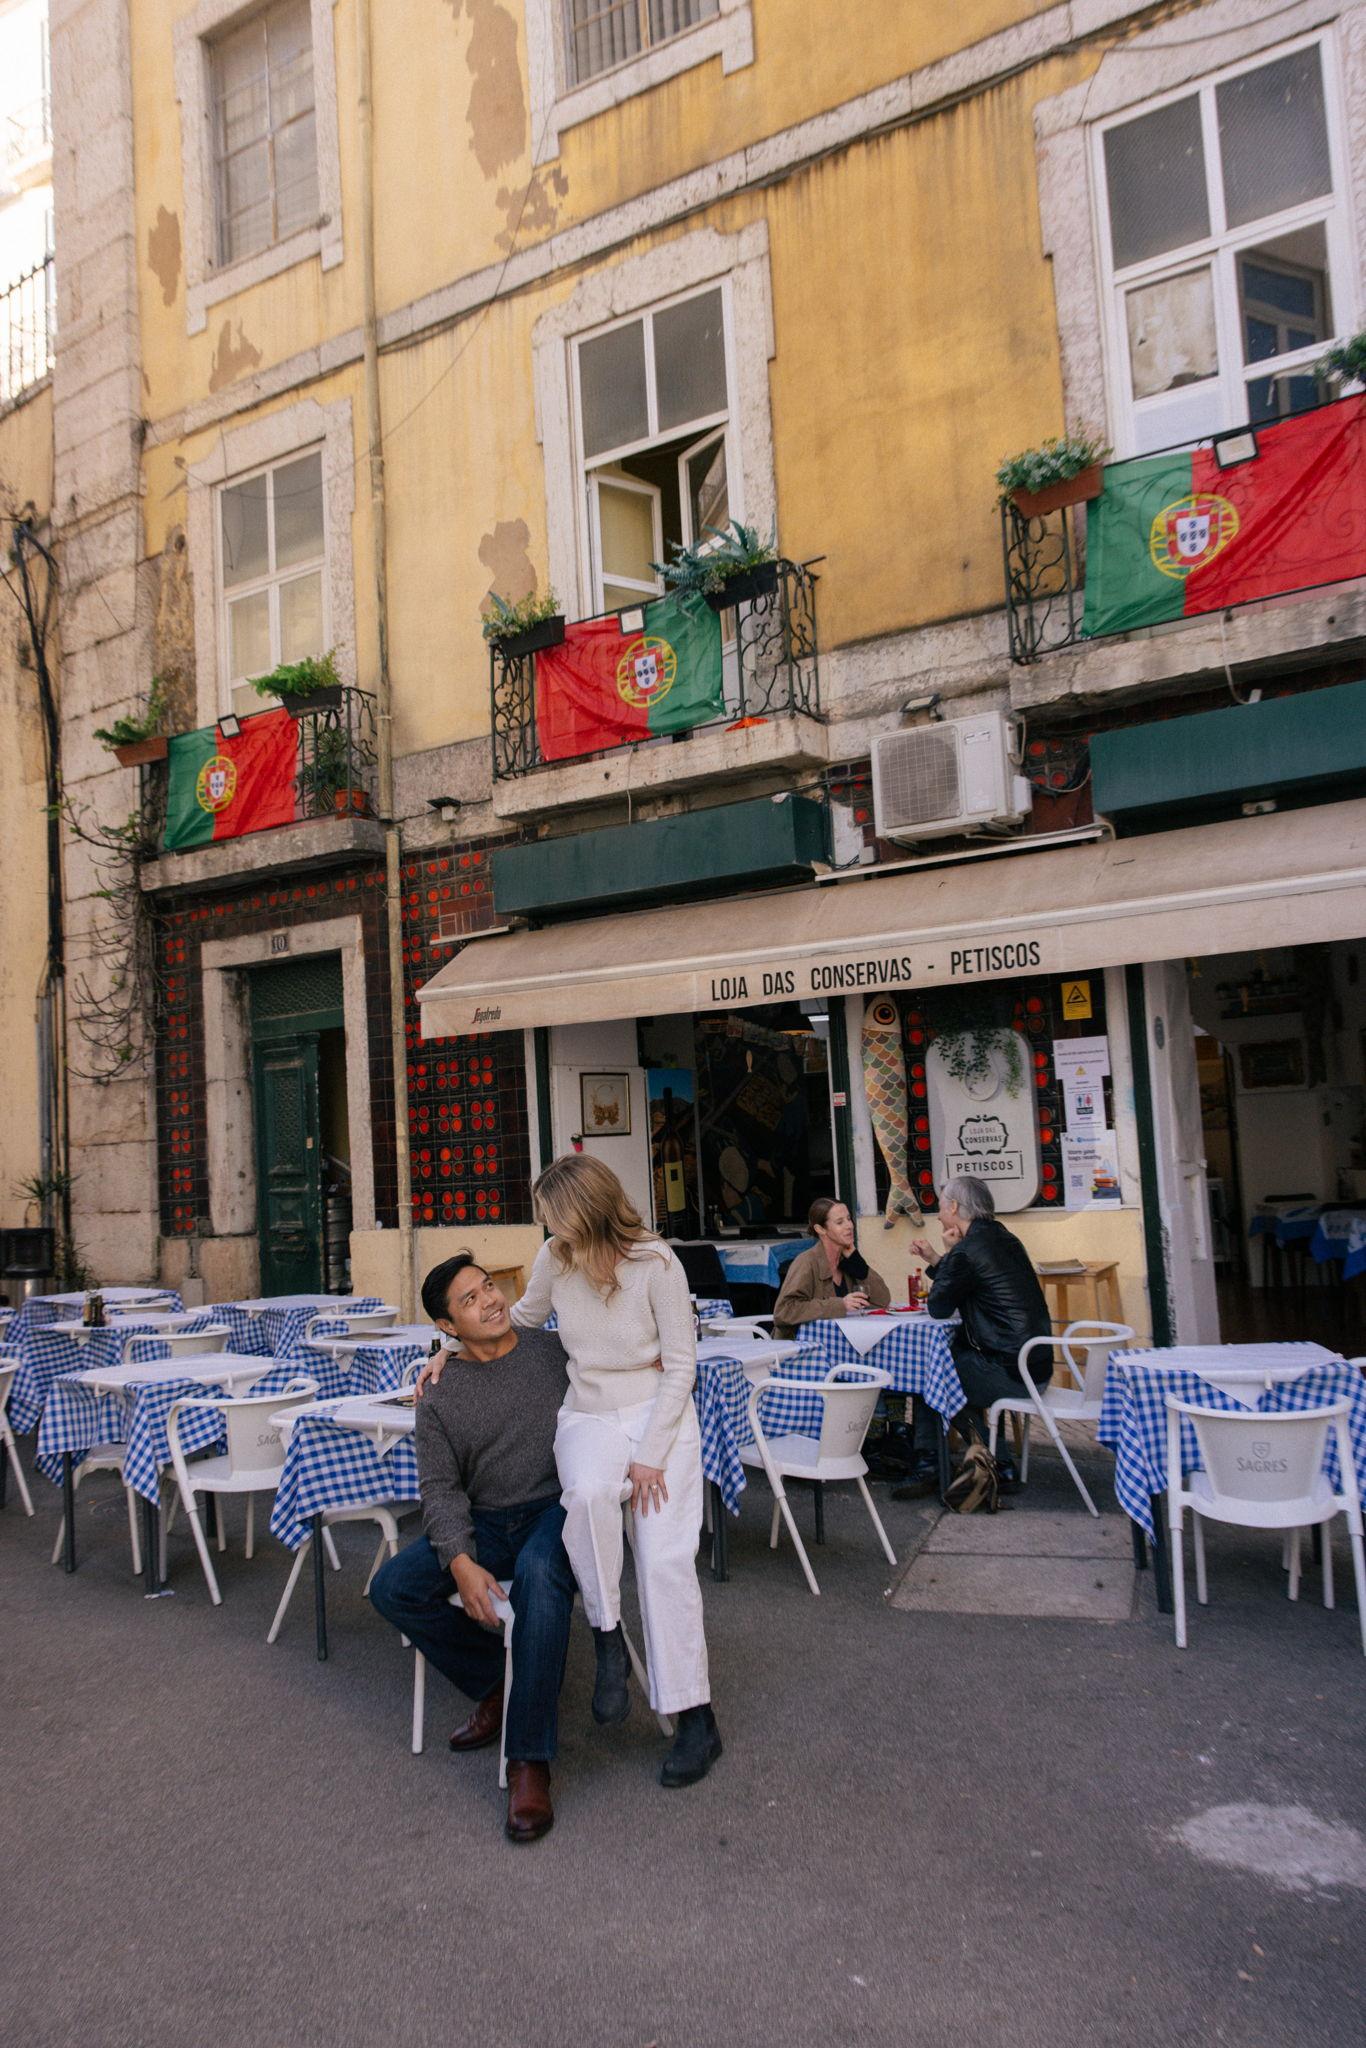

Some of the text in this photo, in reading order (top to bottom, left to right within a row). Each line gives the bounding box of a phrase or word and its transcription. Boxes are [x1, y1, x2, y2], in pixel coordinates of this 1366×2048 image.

[274, 936, 285, 950] 10
[711, 976, 749, 1001] LOJA
[763, 970, 795, 996] DAS
[810, 957, 912, 990] CONSERVAS
[951, 941, 1040, 975] PETISCOS
[965, 1136, 1002, 1144] CONSERVAS
[956, 1161, 1013, 1173] PETISCOS
[1236, 1457, 1288, 1473] SAGRES
